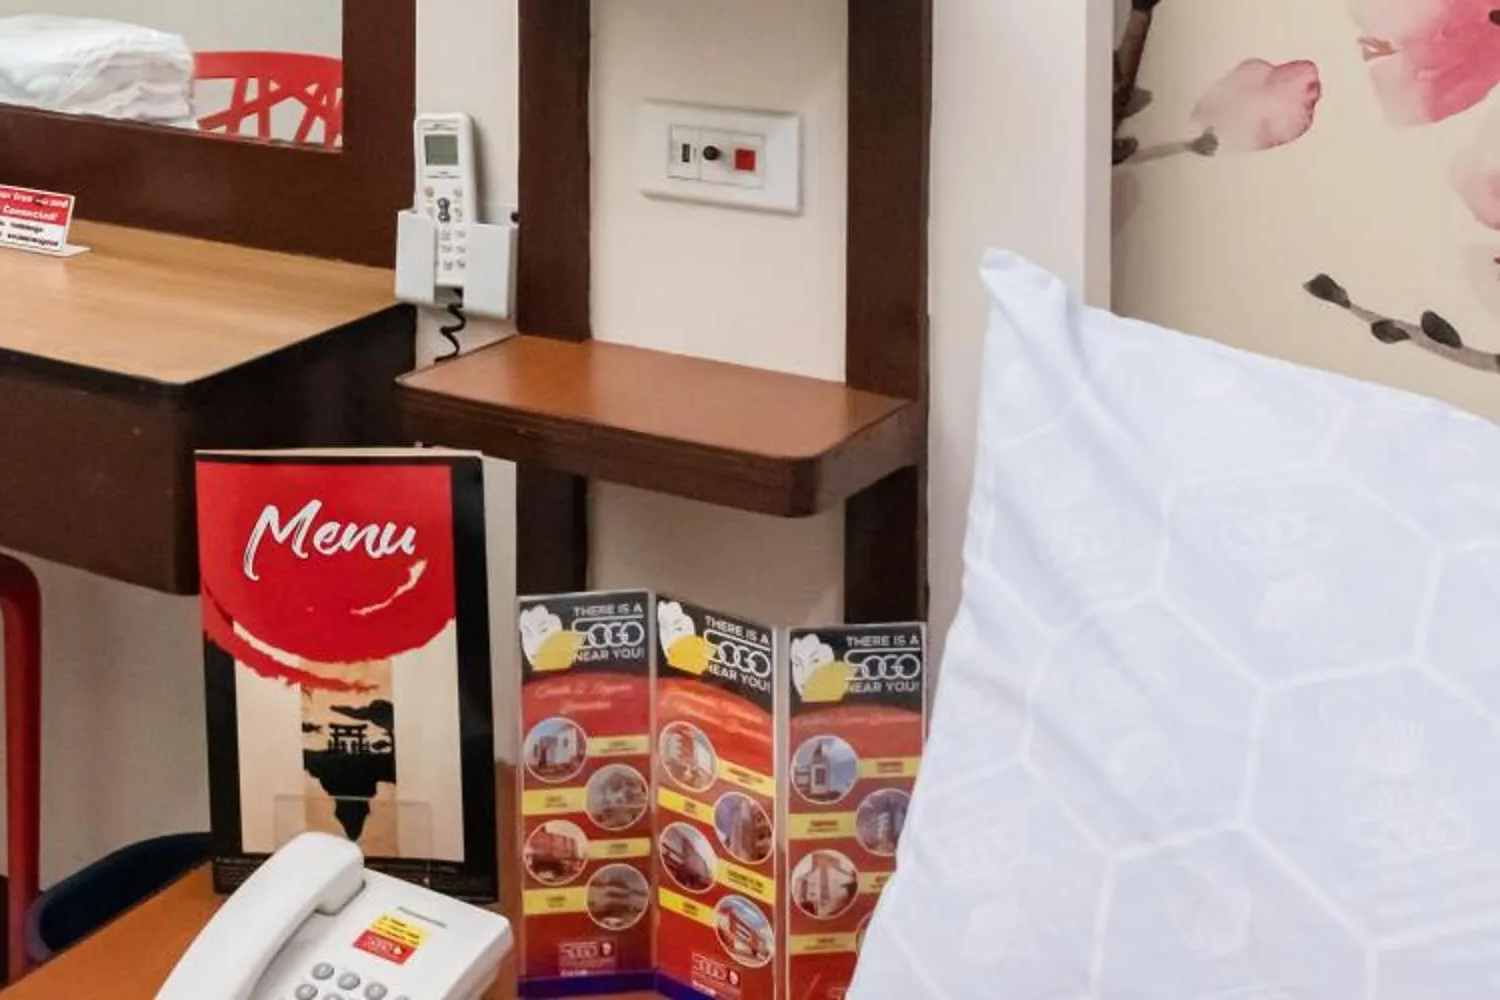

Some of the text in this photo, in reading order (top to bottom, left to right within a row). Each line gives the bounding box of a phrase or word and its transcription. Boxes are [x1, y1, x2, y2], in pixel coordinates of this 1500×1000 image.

[13, 191, 33, 202] free
[243, 499, 415, 581] Menu
[572, 602, 643, 617] THERE IS A
[704, 615, 770, 644] THERE IS A
[846, 635, 919, 647] THERE IS A
[612, 647, 645, 660] YOU!
[739, 674, 771, 694] YOU!
[884, 680, 920, 693] YOU!
